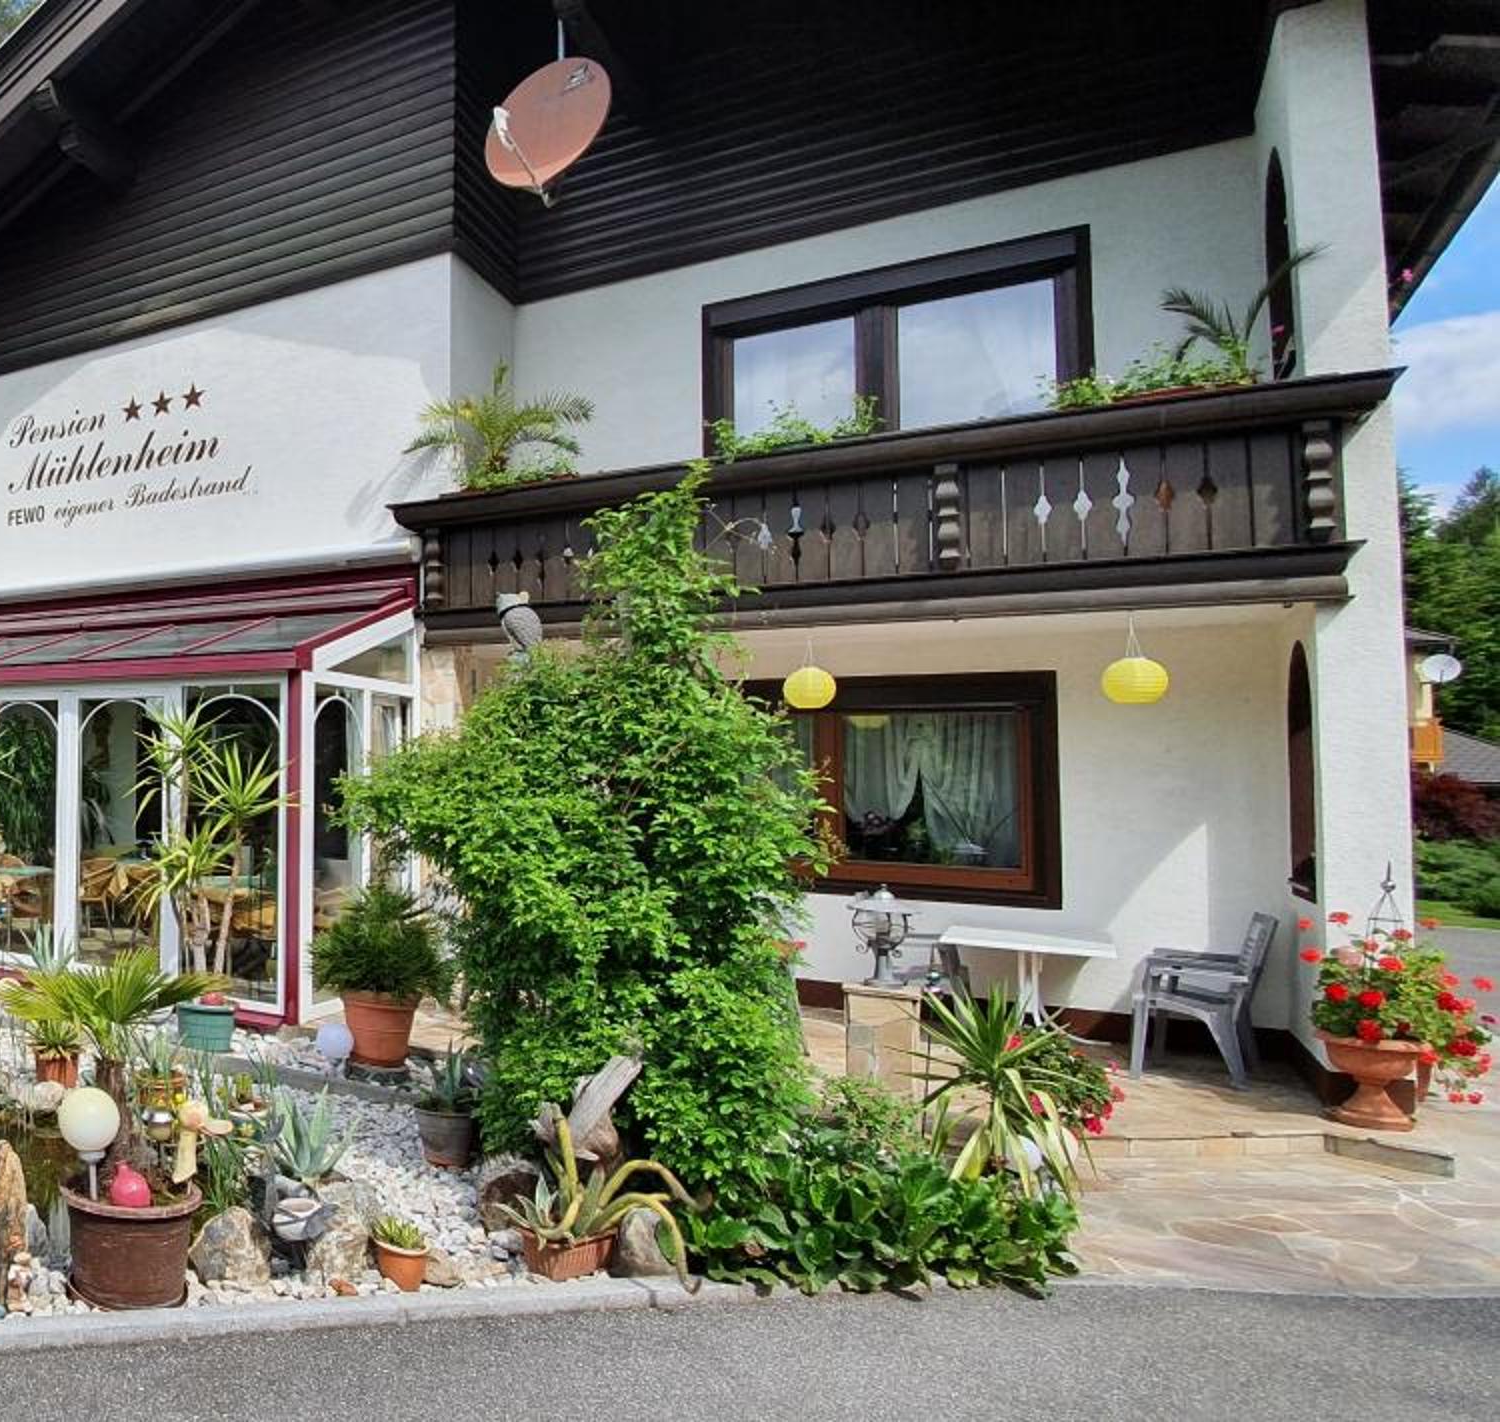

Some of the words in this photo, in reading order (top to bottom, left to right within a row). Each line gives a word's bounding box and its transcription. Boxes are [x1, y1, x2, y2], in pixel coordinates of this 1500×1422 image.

[9, 409, 105, 448] Pension
[7, 430, 219, 494] Mühlenheim
[7, 505, 45, 526] FEWO
[53, 499, 114, 528] eigener
[125, 465, 252, 508] Badestrand
